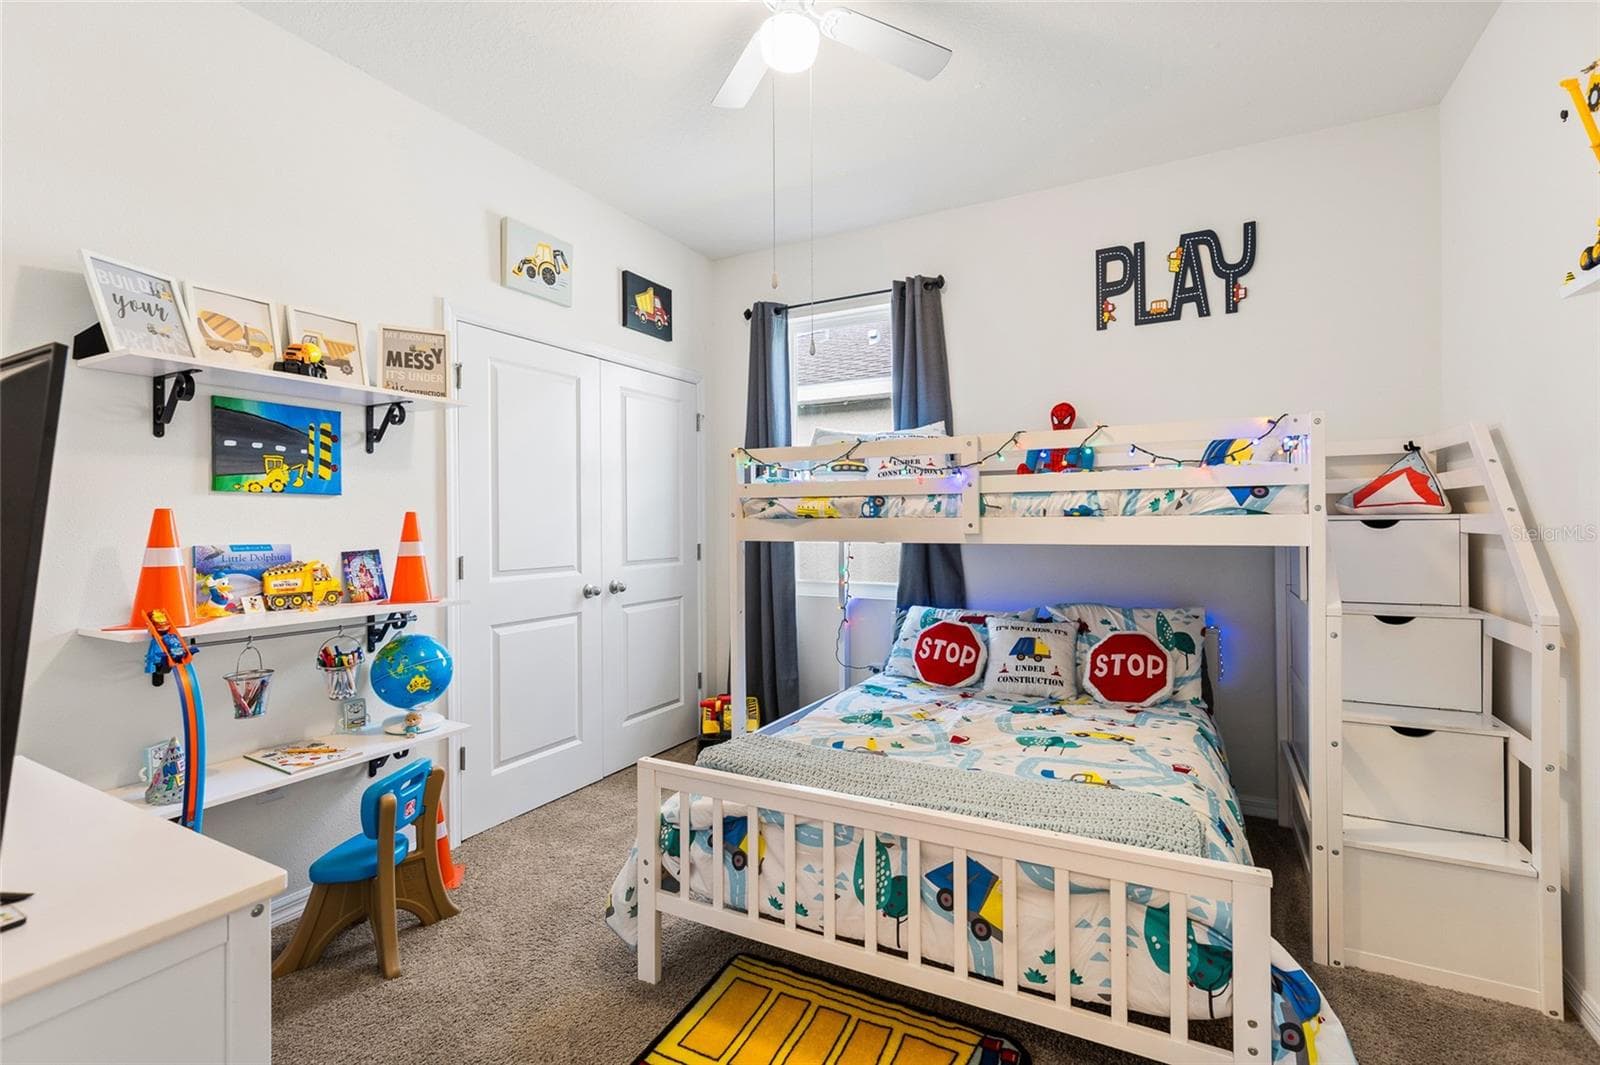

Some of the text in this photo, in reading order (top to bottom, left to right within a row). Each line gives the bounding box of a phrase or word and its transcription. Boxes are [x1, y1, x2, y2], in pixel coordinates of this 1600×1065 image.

[96, 268, 150, 294] BUILD
[1095, 221, 1256, 331] PLAY
[112, 292, 169, 322] your
[386, 348, 443, 371] MESSY
[387, 371, 444, 383] IT'S UNDER
[221, 553, 286, 565] Little Dolphin
[918, 639, 977, 667] STOP
[1015, 664, 1046, 673] UNDER
[1094, 652, 1164, 679] STOP
[997, 676, 1065, 687] CONSTRUCTION
